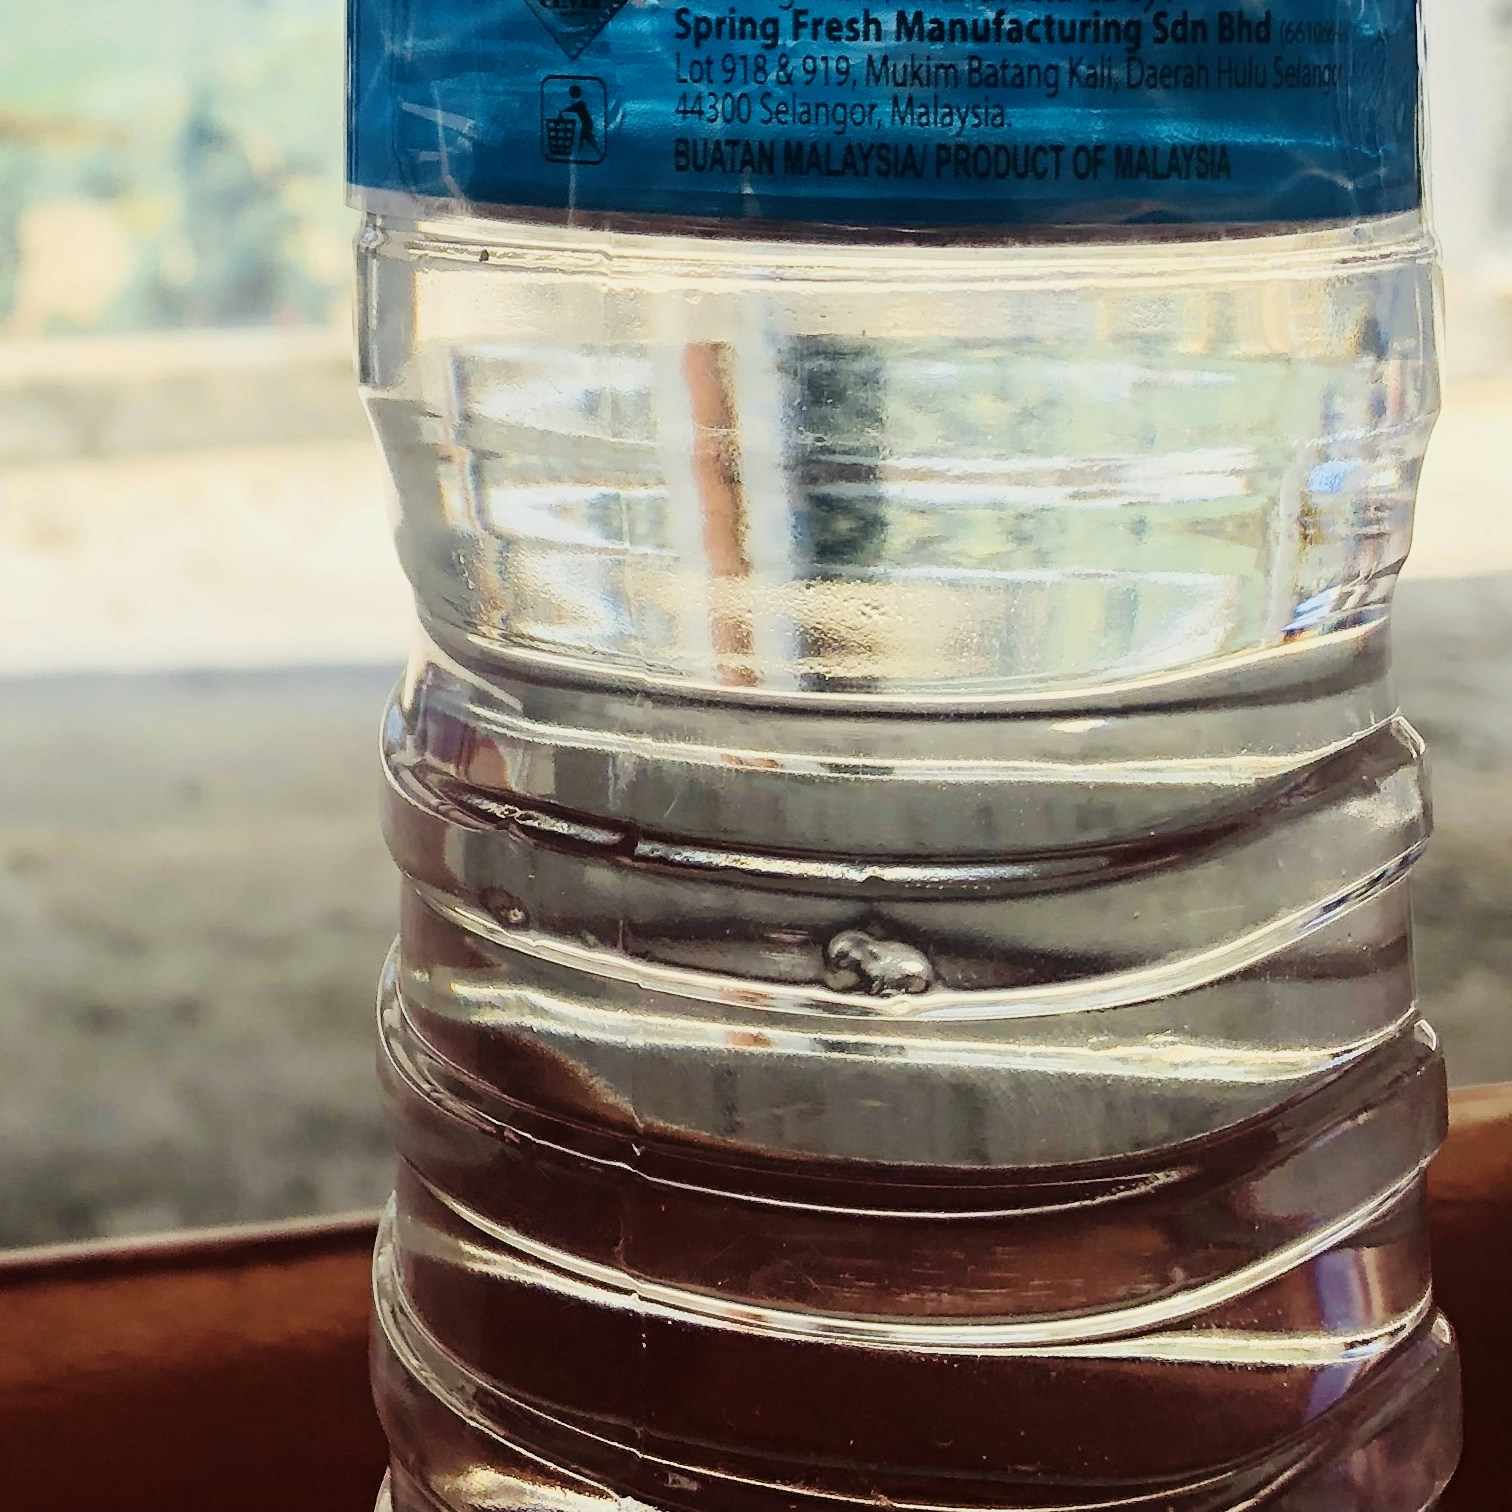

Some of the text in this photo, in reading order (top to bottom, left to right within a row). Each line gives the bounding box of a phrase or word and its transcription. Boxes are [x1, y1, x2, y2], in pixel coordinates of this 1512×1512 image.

[675, 7, 779, 50] Spring
[792, 8, 883, 43] Fresh
[895, 8, 1141, 53] Manufacturing
[1152, 10, 1208, 45] Sdn
[1218, 8, 1271, 45] Bhd
[676, 51, 713, 85] Lot
[721, 52, 768, 86] 918
[777, 52, 794, 87] &
[801, 53, 856, 91] 919,
[865, 53, 959, 89] Mukim
[968, 54, 1059, 98] Batang
[1126, 54, 1210, 90] Daerah
[1218, 54, 1267, 90] Hulu
[675, 91, 1013, 138] 44300 Selangor, Malaysia.
[675, 138, 774, 176] BUATAN
[937, 142, 1065, 180] PRODUCT
[1073, 144, 1107, 181] OF
[1114, 144, 1232, 181] MALAYSIA
